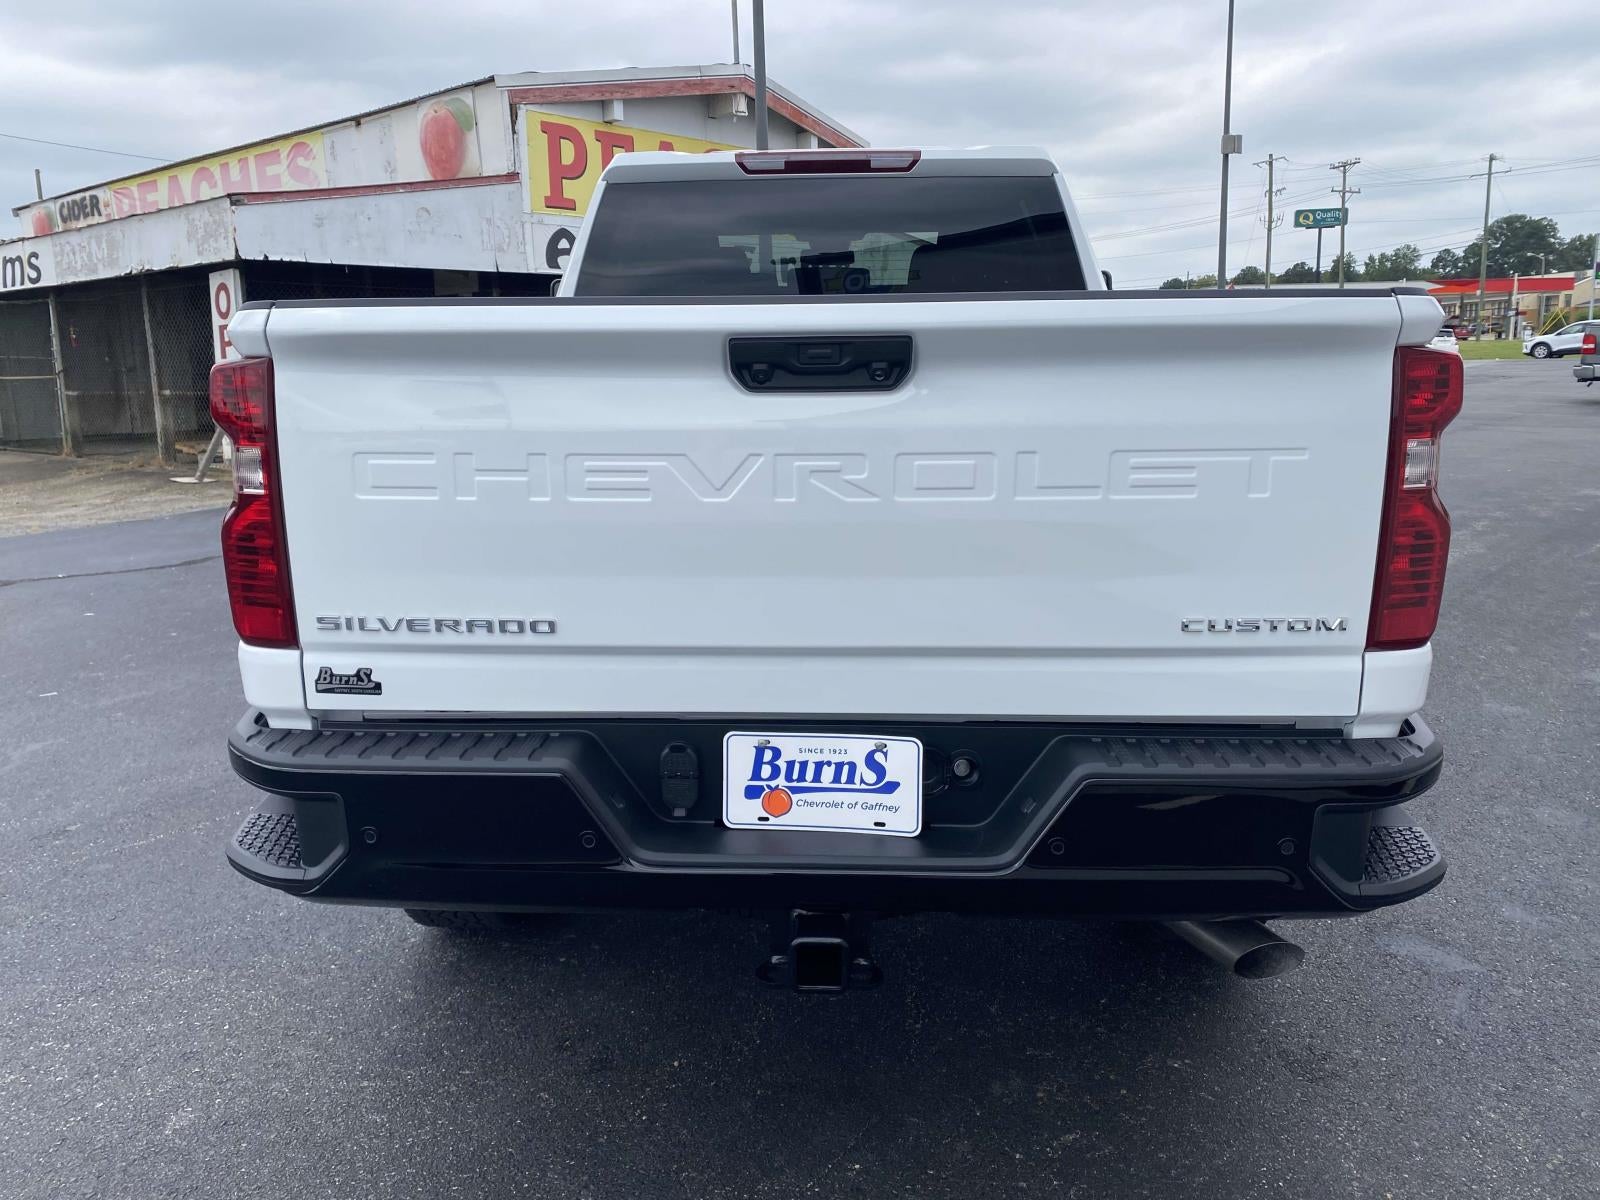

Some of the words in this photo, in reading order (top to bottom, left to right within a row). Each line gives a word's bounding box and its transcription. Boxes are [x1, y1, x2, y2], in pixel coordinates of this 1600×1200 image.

[112, 140, 320, 219] PEACHES
[58, 194, 102, 224] CIDER
[352, 448, 1310, 502] CHEVROLET
[316, 615, 557, 634] SILVERADO
[1181, 616, 1349, 632] CUSTOM
[799, 747, 825, 755] SINCE
[795, 799, 844, 809] Chevrolet
[847, 800, 860, 810] of
[860, 801, 901, 814] Gaffney
